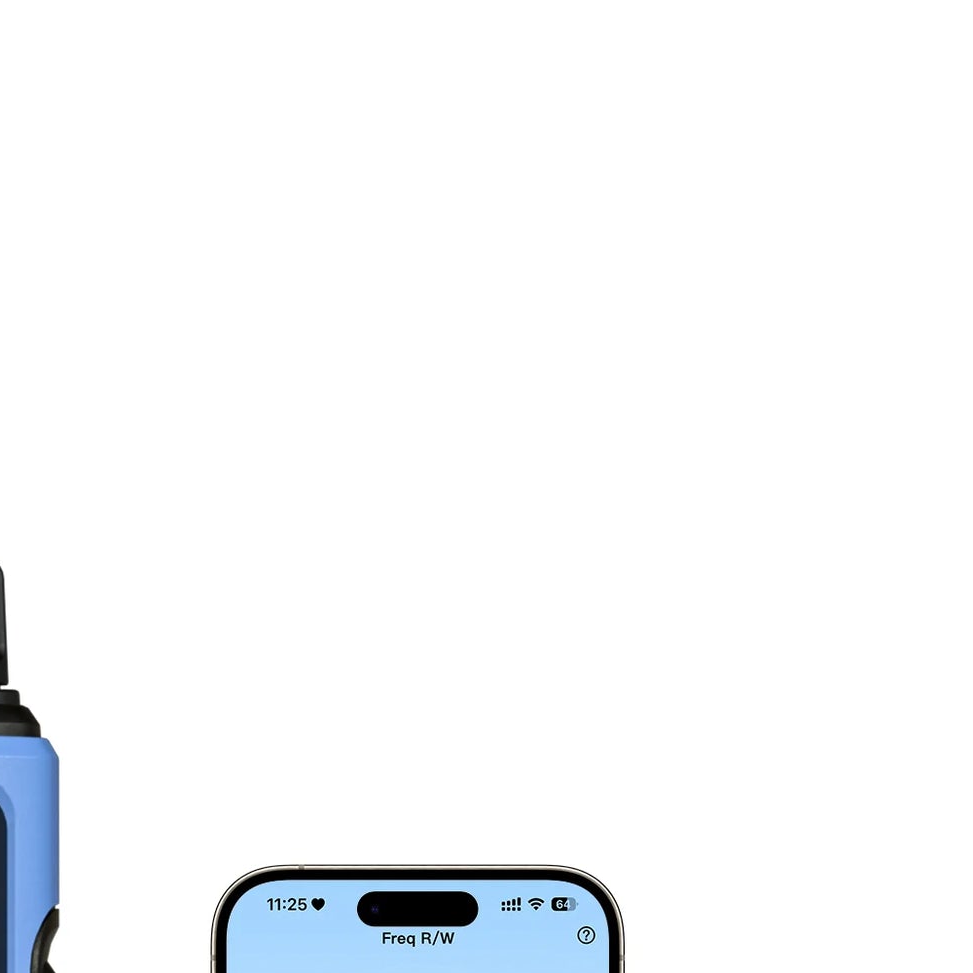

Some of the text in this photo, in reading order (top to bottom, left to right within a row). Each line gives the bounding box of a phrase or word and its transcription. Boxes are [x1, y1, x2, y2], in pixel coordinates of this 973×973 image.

[267, 898, 307, 911] 11:25
[383, 931, 454, 947] Freq R/W
